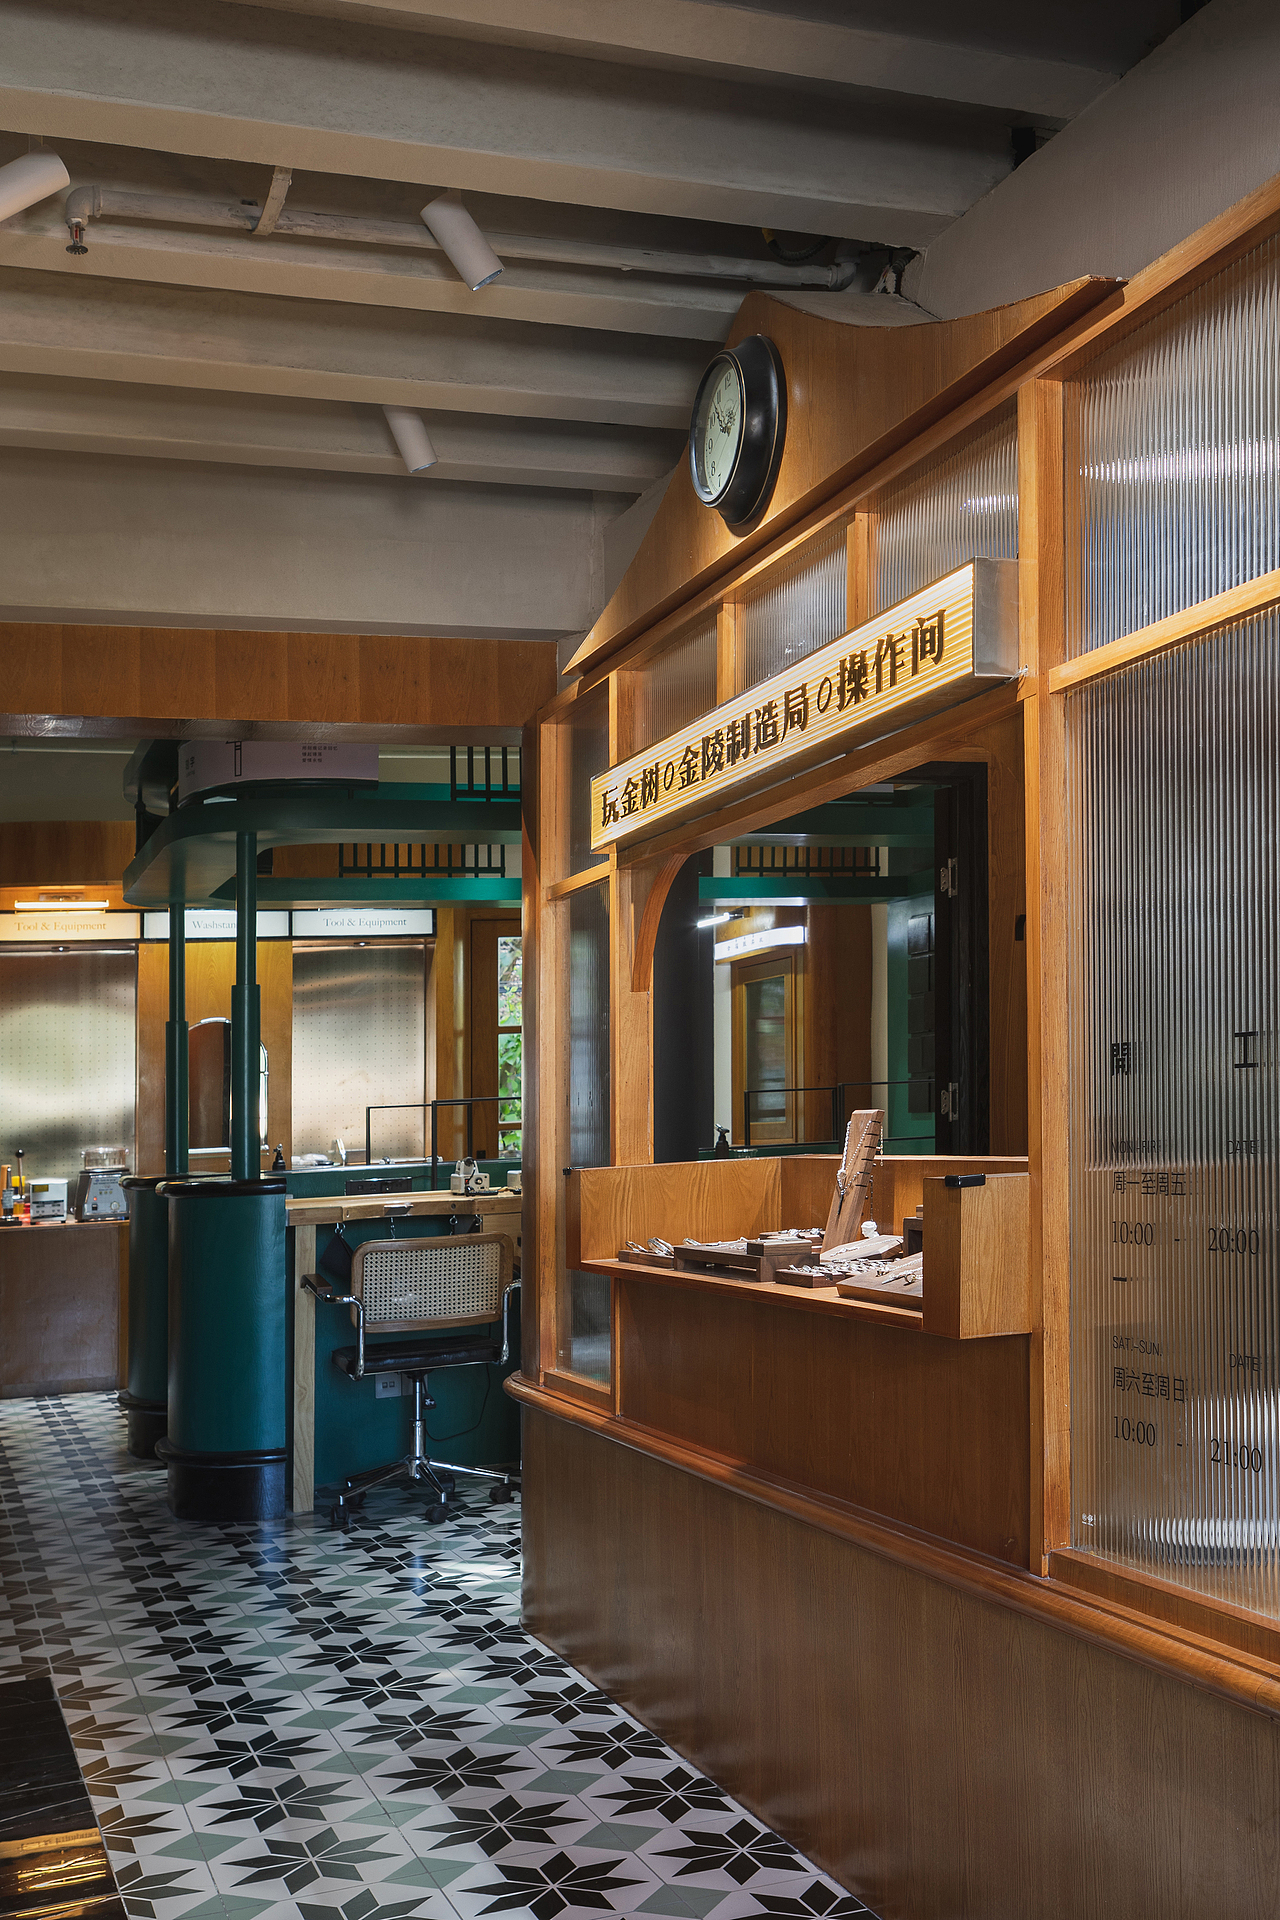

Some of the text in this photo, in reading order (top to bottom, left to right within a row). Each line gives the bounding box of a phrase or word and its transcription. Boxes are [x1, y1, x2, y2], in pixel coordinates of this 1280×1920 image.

[14, 921, 107, 933] Tool & Equipment
[192, 919, 237, 930] Washstan
[323, 917, 408, 929] Tool & Equipment
[1112, 1171, 1187, 1196] 周一至周五
[1112, 1221, 1154, 1246] 10:00
[1207, 1227, 1261, 1256] 20:00
[1112, 1366, 1185, 1404] 周六至周日
[1113, 1416, 1156, 1447] 10:00
[1210, 1438, 1263, 1473] 21:00
